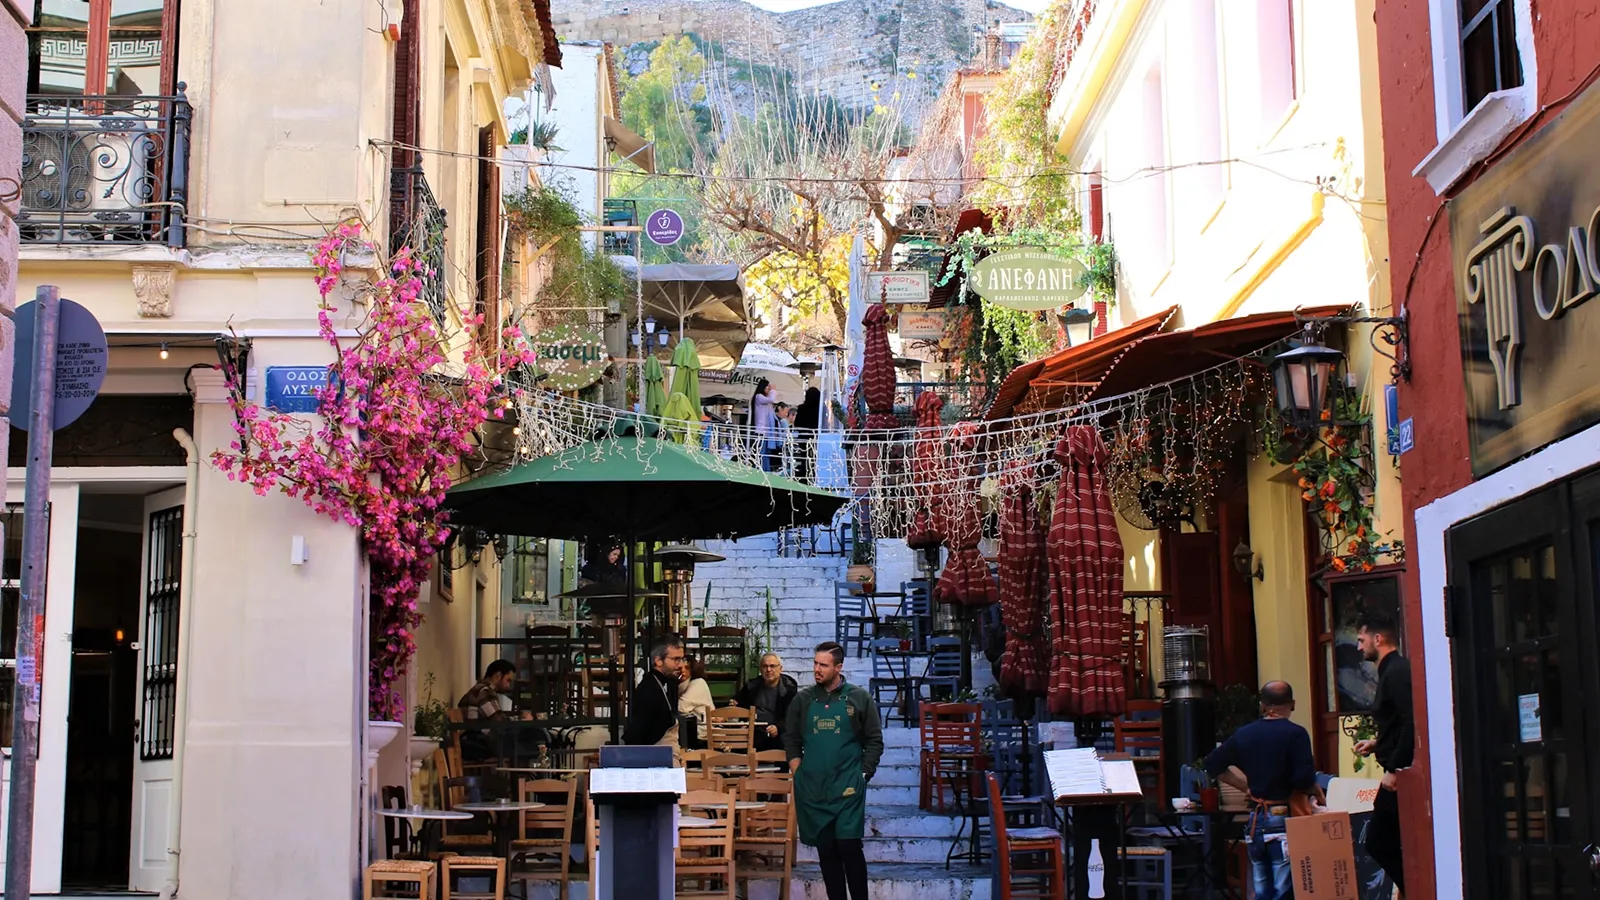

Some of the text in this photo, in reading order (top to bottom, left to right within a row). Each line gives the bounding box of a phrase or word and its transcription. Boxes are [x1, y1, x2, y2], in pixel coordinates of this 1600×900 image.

[987, 267, 1074, 290] ΑΝΕΦΑΝΗ
[286, 372, 328, 380] ΟΔΟΣ
[1402, 424, 1412, 446] 22
